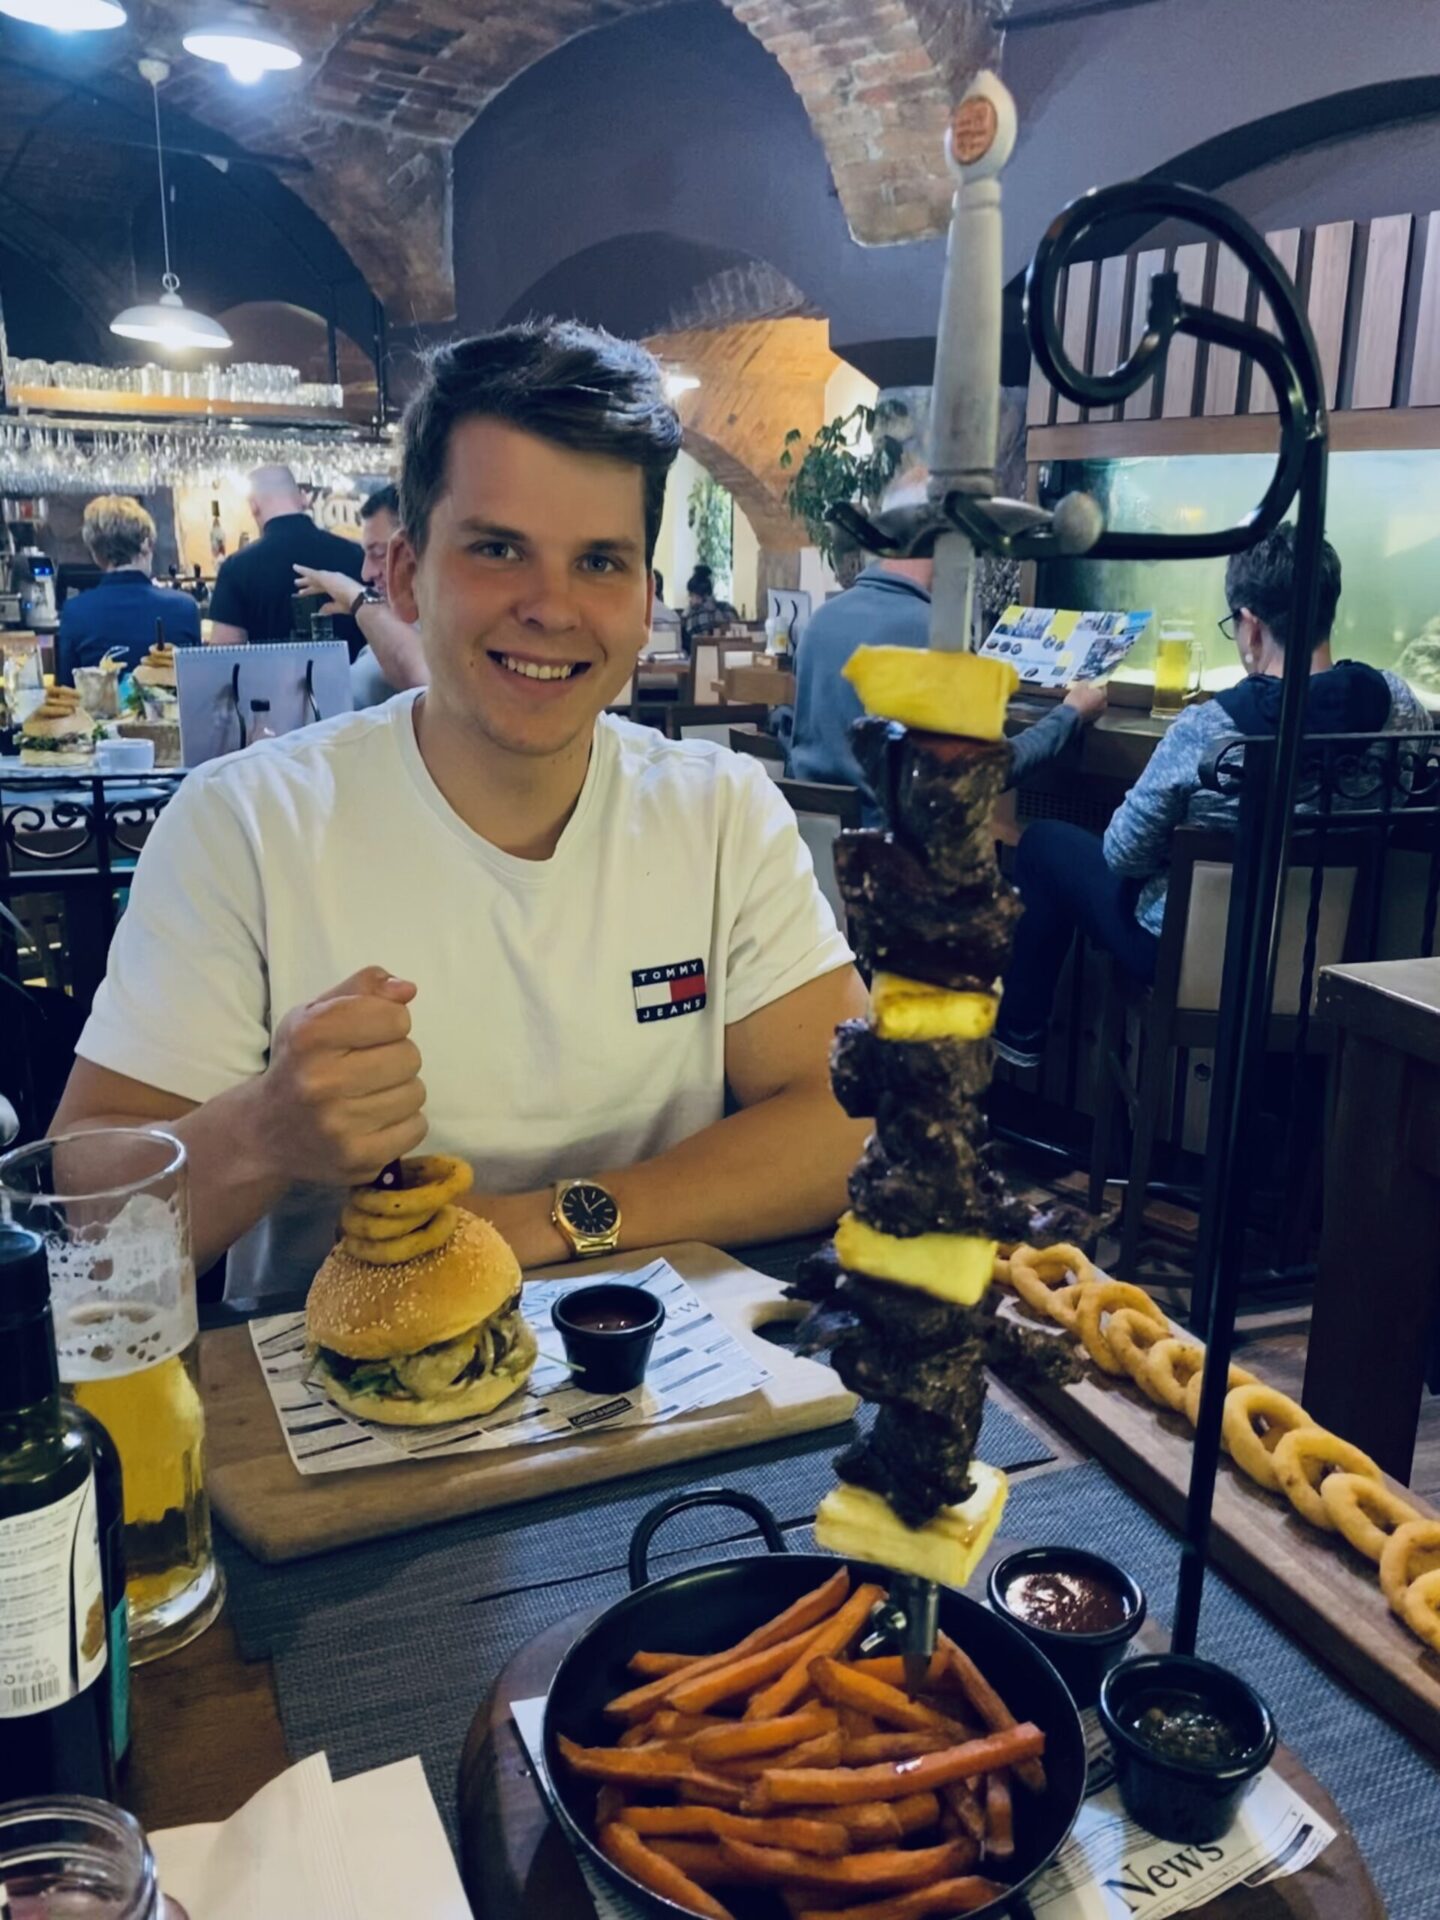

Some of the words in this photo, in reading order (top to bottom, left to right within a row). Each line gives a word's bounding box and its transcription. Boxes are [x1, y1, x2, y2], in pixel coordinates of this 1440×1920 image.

[638, 962, 698, 982] TOMMY
[643, 999, 701, 1019] JEANS
[1102, 1844, 1225, 1913] News
